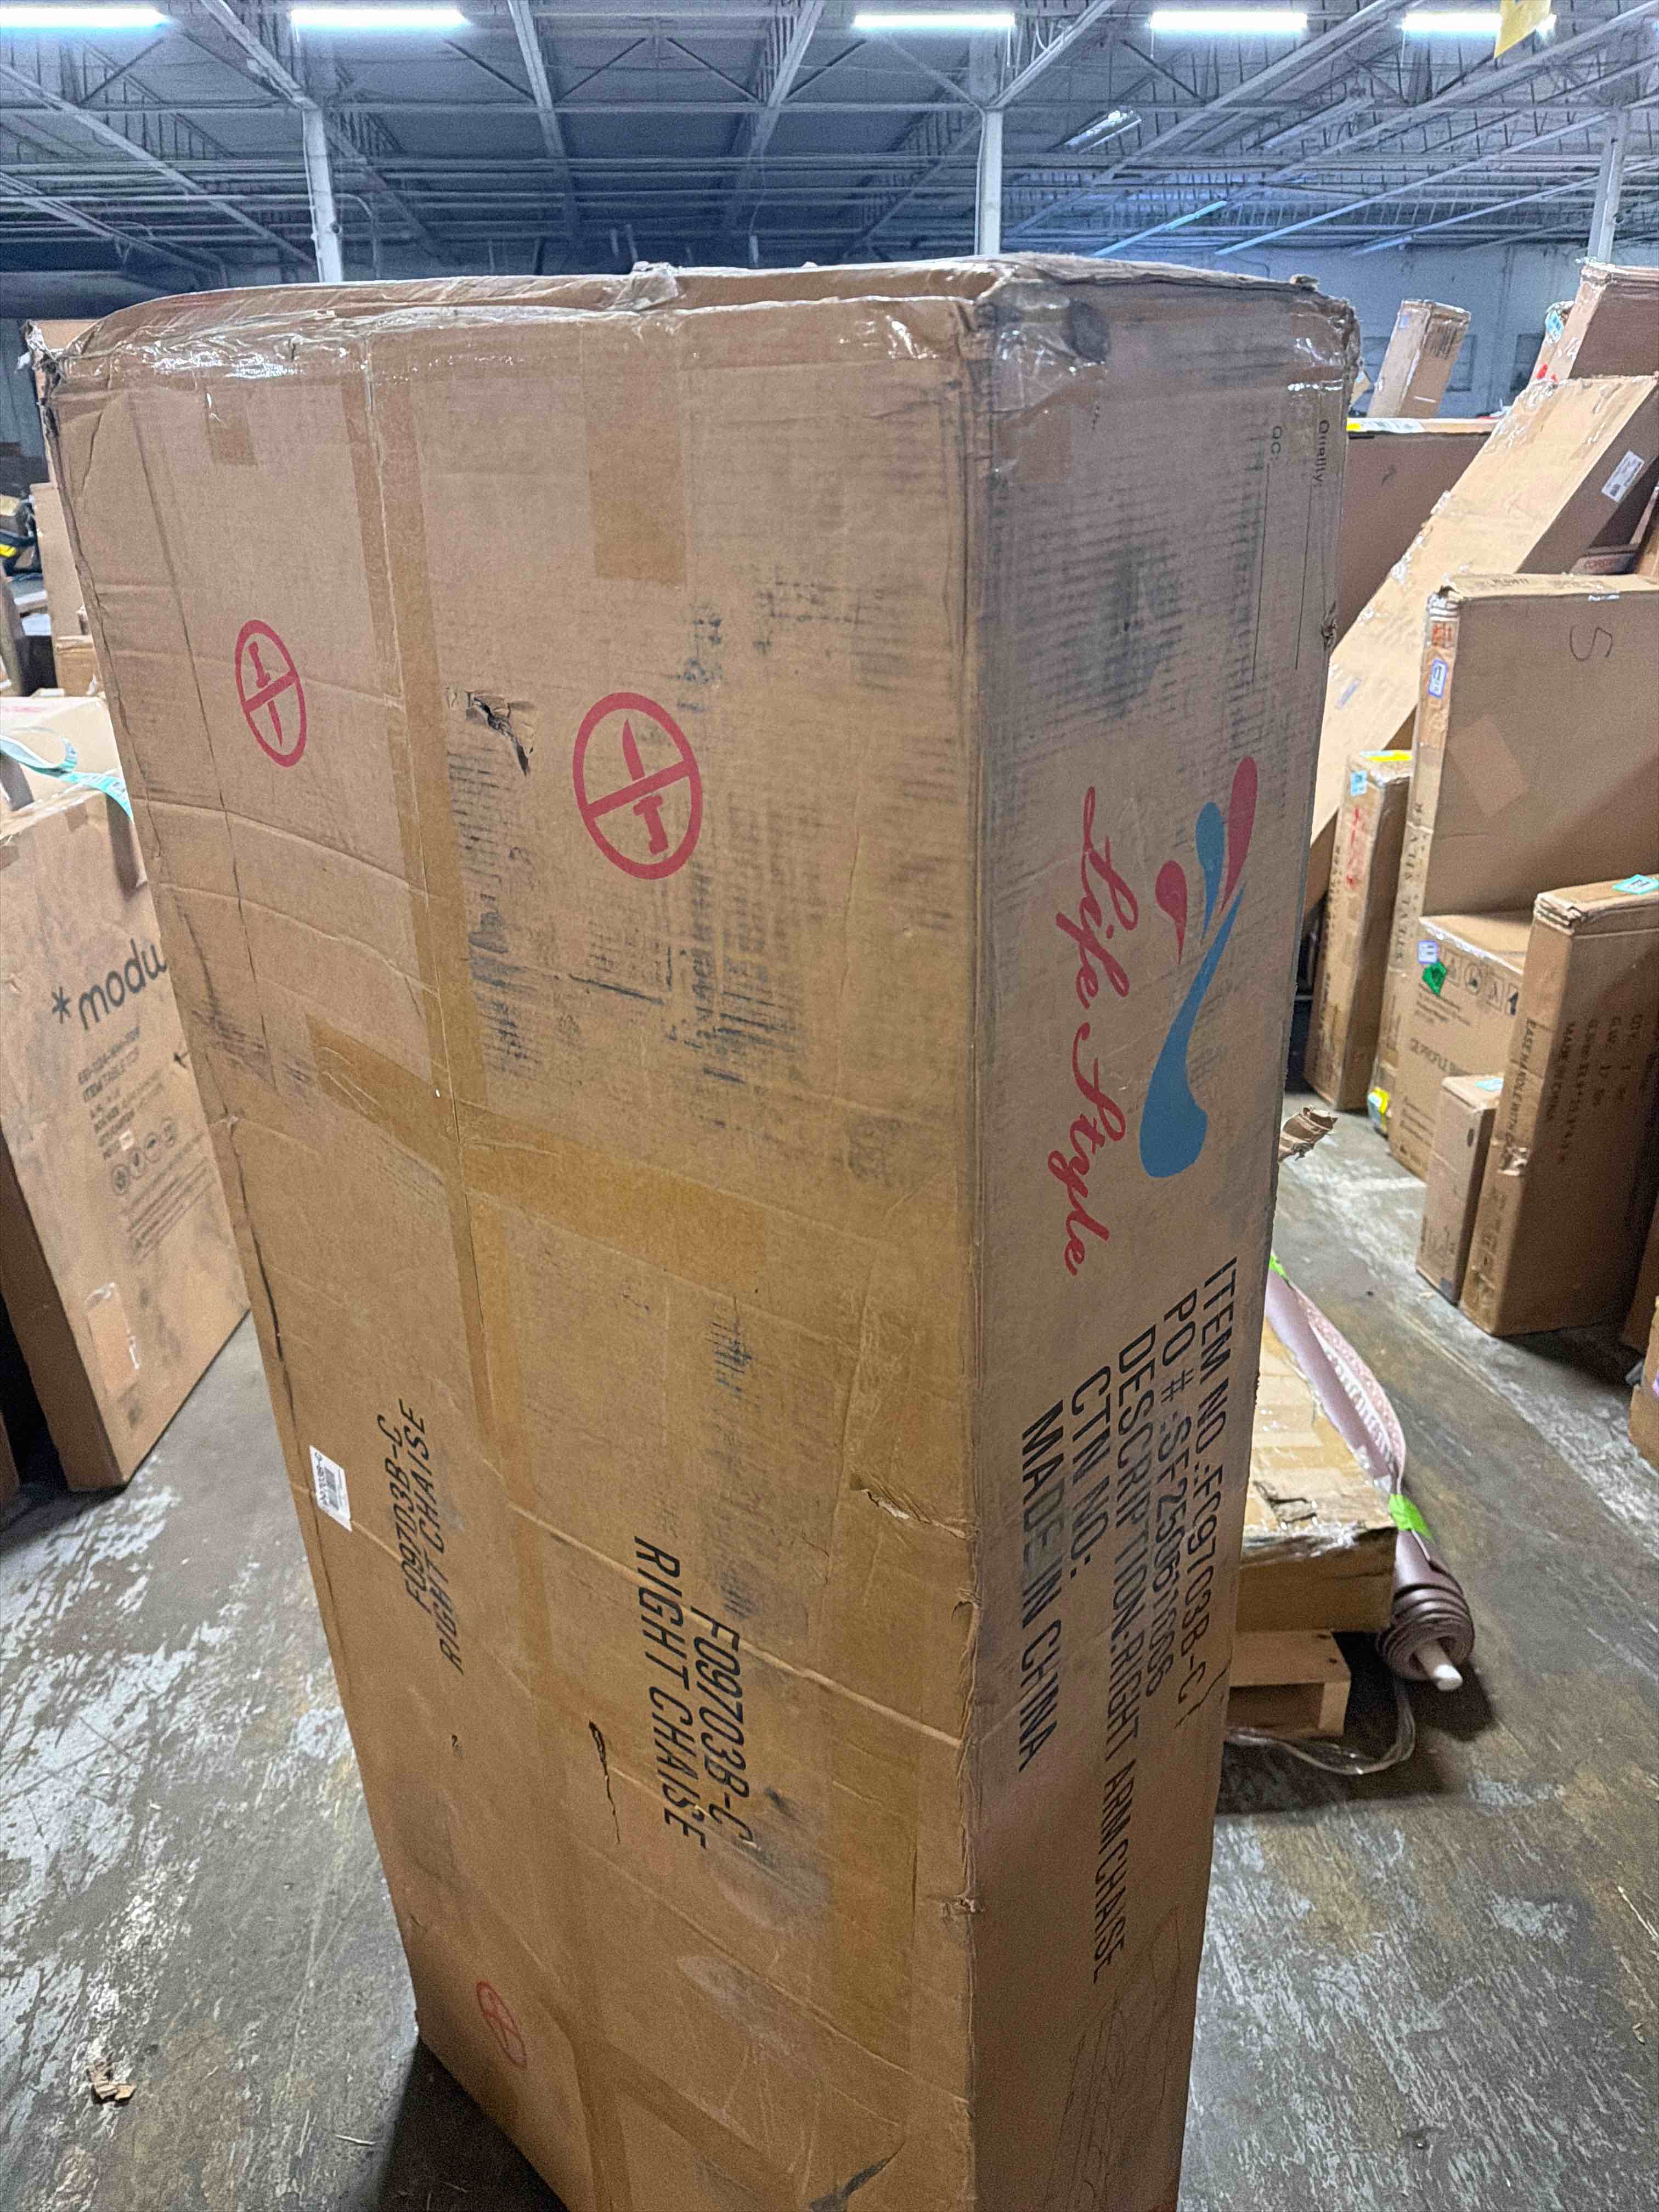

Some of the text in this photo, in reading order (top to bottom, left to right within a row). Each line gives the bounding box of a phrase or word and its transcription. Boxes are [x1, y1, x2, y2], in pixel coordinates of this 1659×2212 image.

[1047, 786, 1139, 1276] Life Style
[1163, 1288, 1198, 1367] PO
[1200, 1256, 1238, 1385] ITEM
[1071, 1365, 1111, 1485] CTN
[399, 1398, 465, 1675] RIGHT CHAISE
[1019, 1398, 1064, 1773] MADE IN CHINA
[634, 1536, 707, 1850] RIGHT CHAISE
[1098, 1758, 1137, 1855] ARM
[1093, 1838, 1129, 1984] CHAISE
